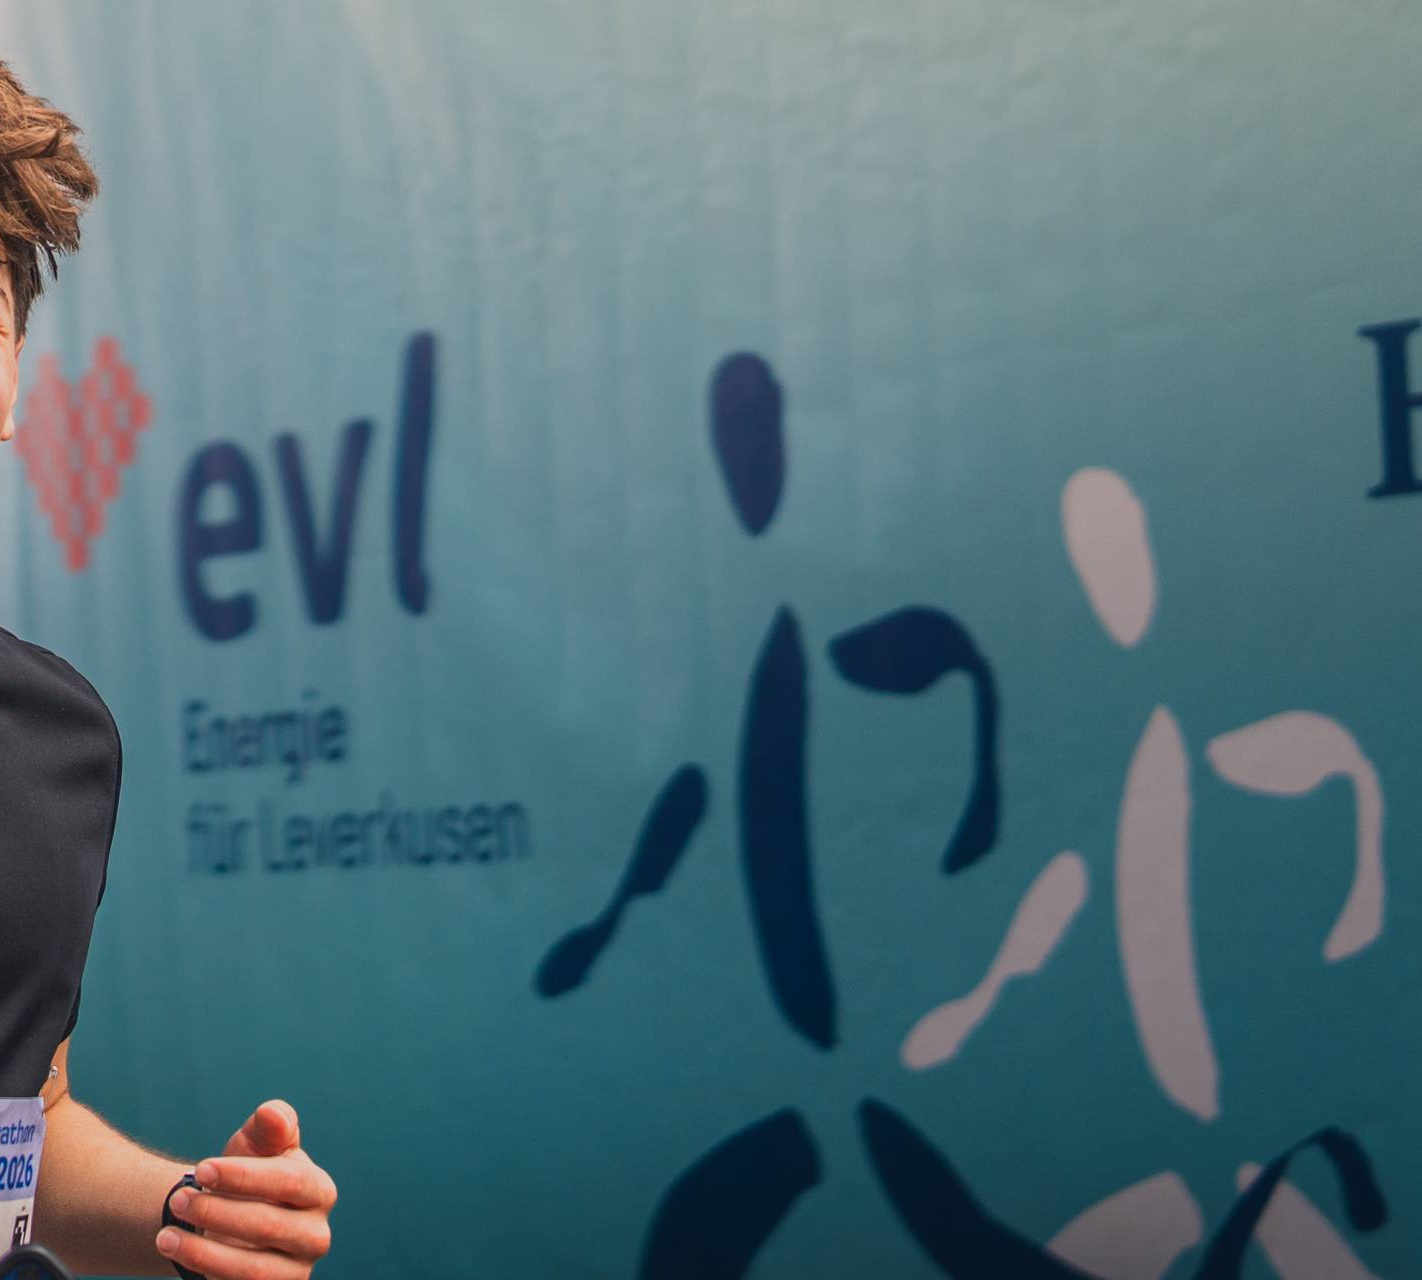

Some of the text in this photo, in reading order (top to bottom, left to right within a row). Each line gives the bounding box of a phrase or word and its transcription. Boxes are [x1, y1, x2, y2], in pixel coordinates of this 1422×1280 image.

[174, 330, 437, 642] evl
[182, 690, 347, 785] Energie
[185, 792, 533, 876] für Leverkusen
